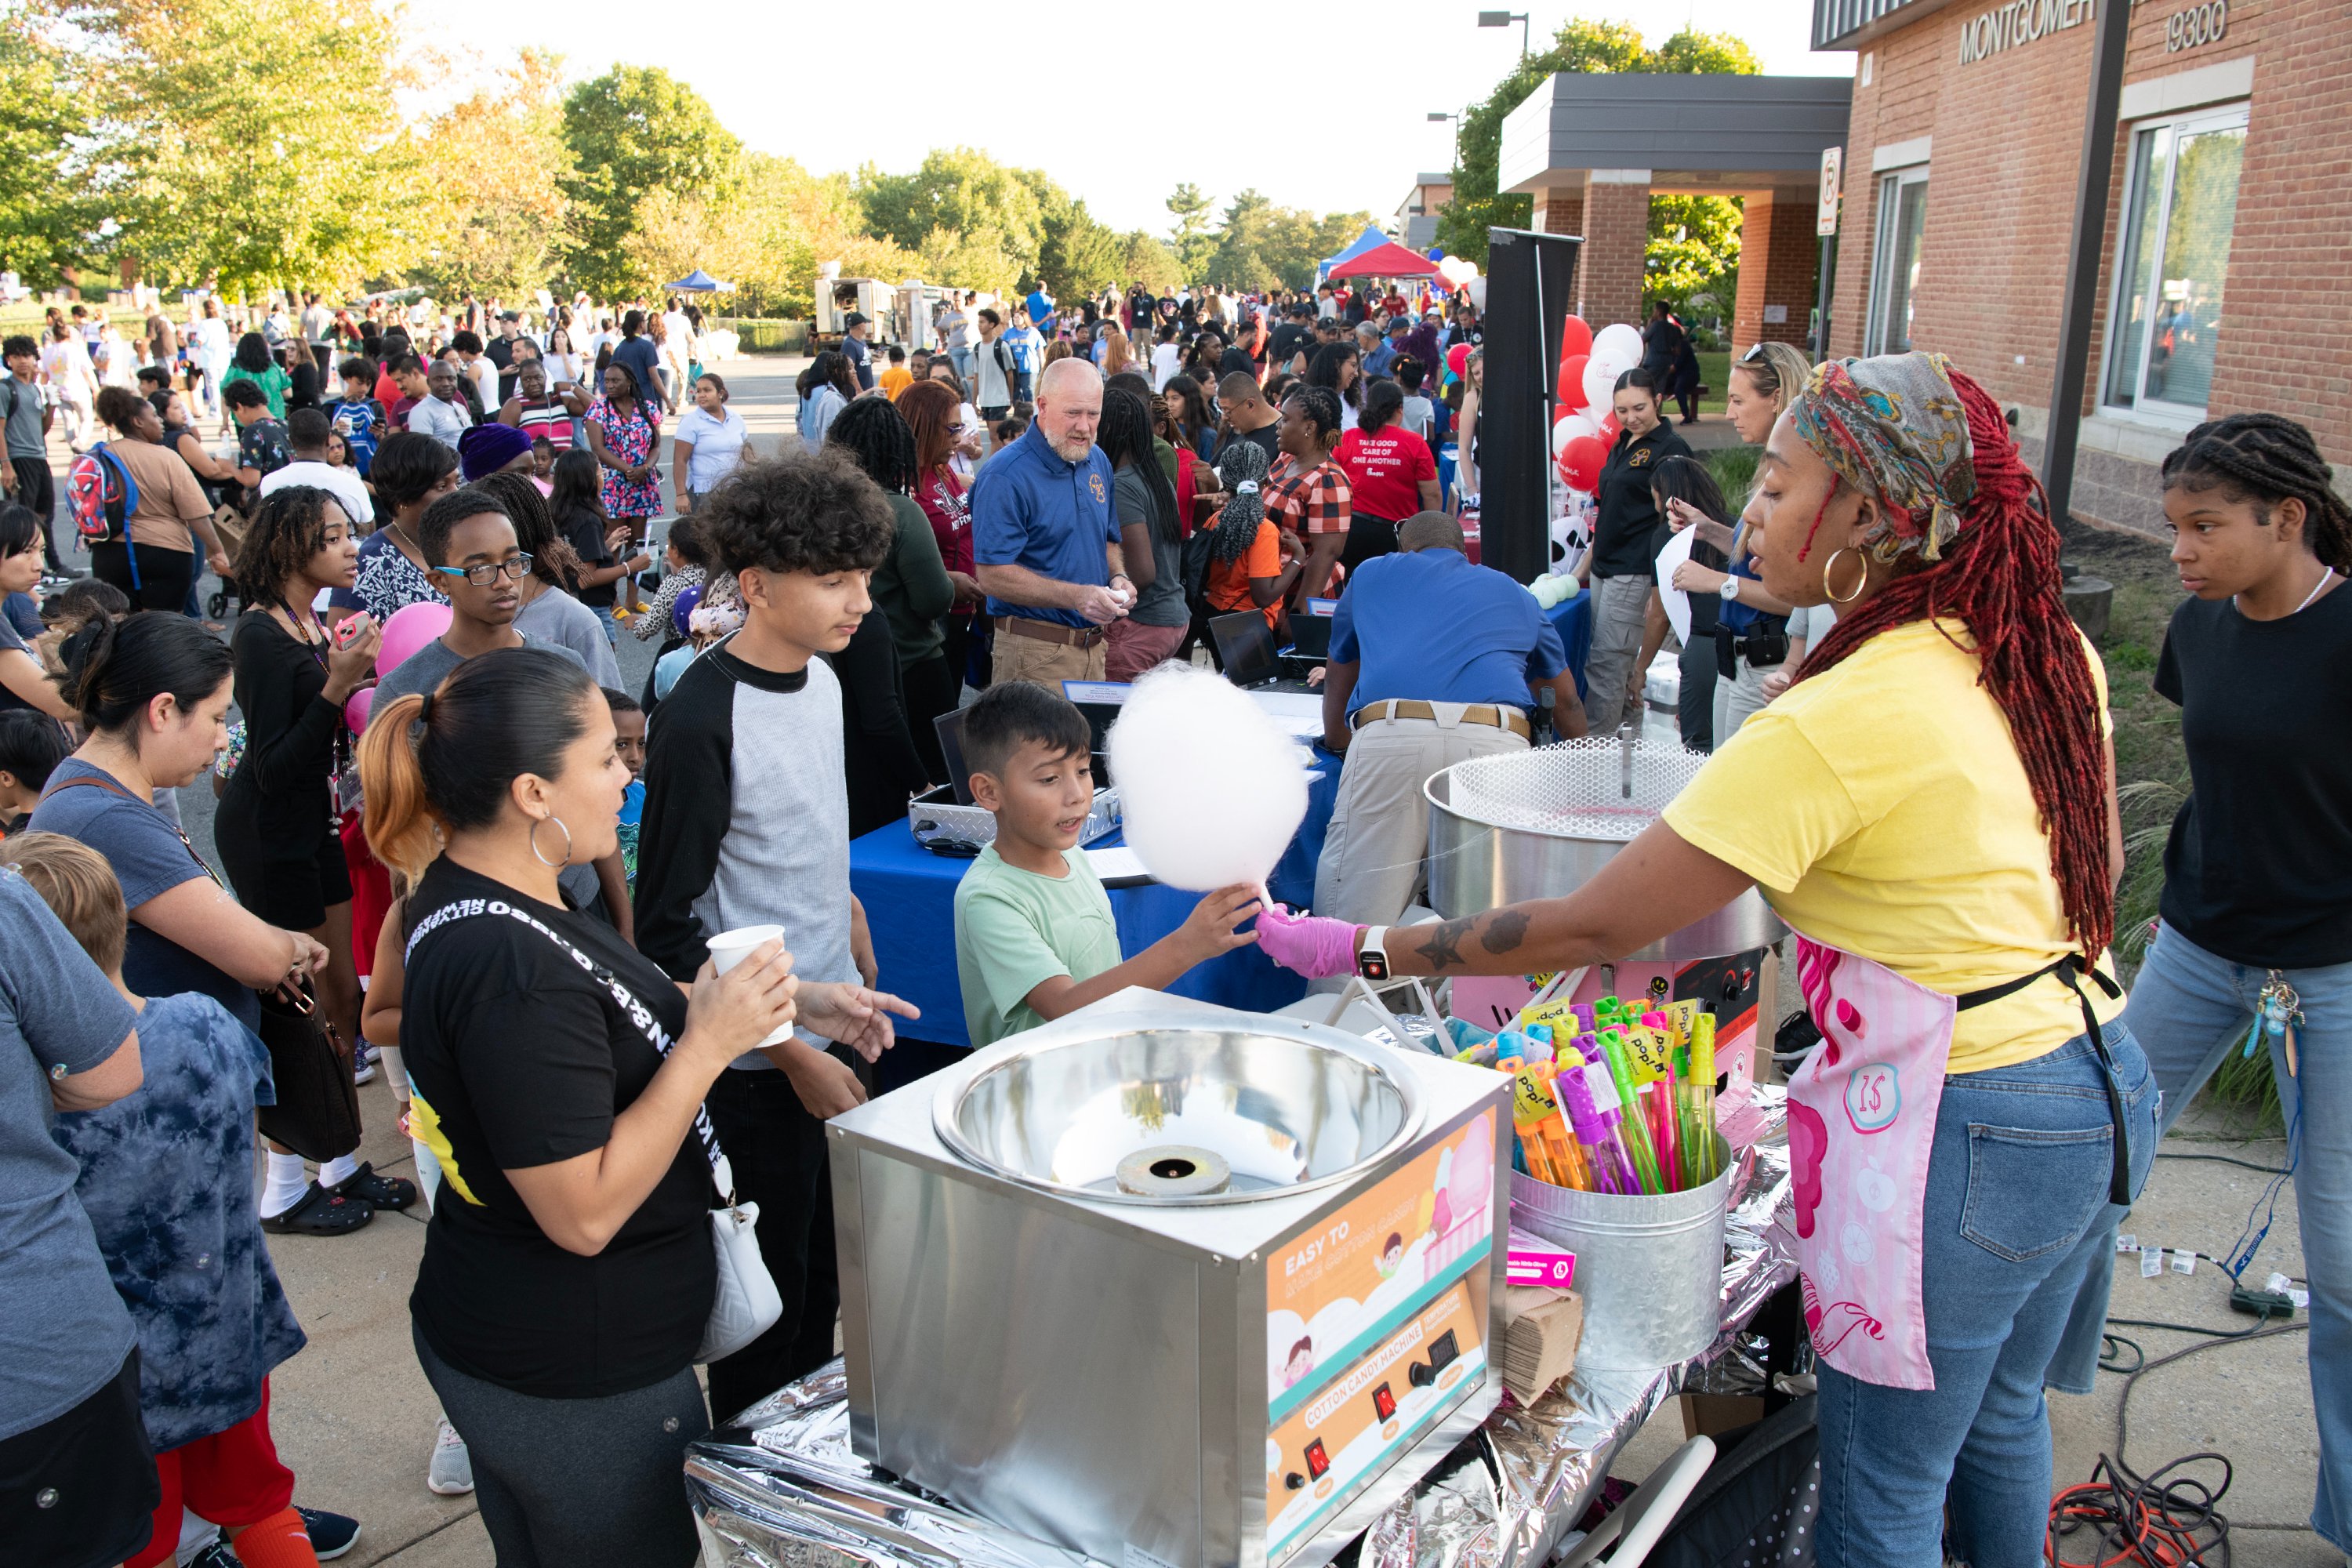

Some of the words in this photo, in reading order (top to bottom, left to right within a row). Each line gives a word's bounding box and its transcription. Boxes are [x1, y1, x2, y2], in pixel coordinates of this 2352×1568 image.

[1958, 0, 2096, 64] MONTGOMER
[2164, 0, 2226, 53] 19300
[1367, 457, 1401, 466] ANOTHER
[1679, 1007, 1689, 1033] pop!
[1631, 1038, 1656, 1066] pop!
[1518, 1076, 1545, 1104] pop!
[1285, 1263, 1323, 1299] MAKE
[1324, 1224, 1376, 1271] COTTON
[1377, 1194, 1418, 1233] CANDY
[1285, 1235, 1326, 1277] EASY
[1329, 1221, 1349, 1247] TO
[2245, 1233, 2263, 1259] HOLLISTER
[1424, 1291, 1460, 1324] TEMPERATURE
[1306, 1385, 1348, 1426] COTTON
[1348, 1361, 1380, 1392] CANDY
[1380, 1324, 1422, 1364] MACHINE
